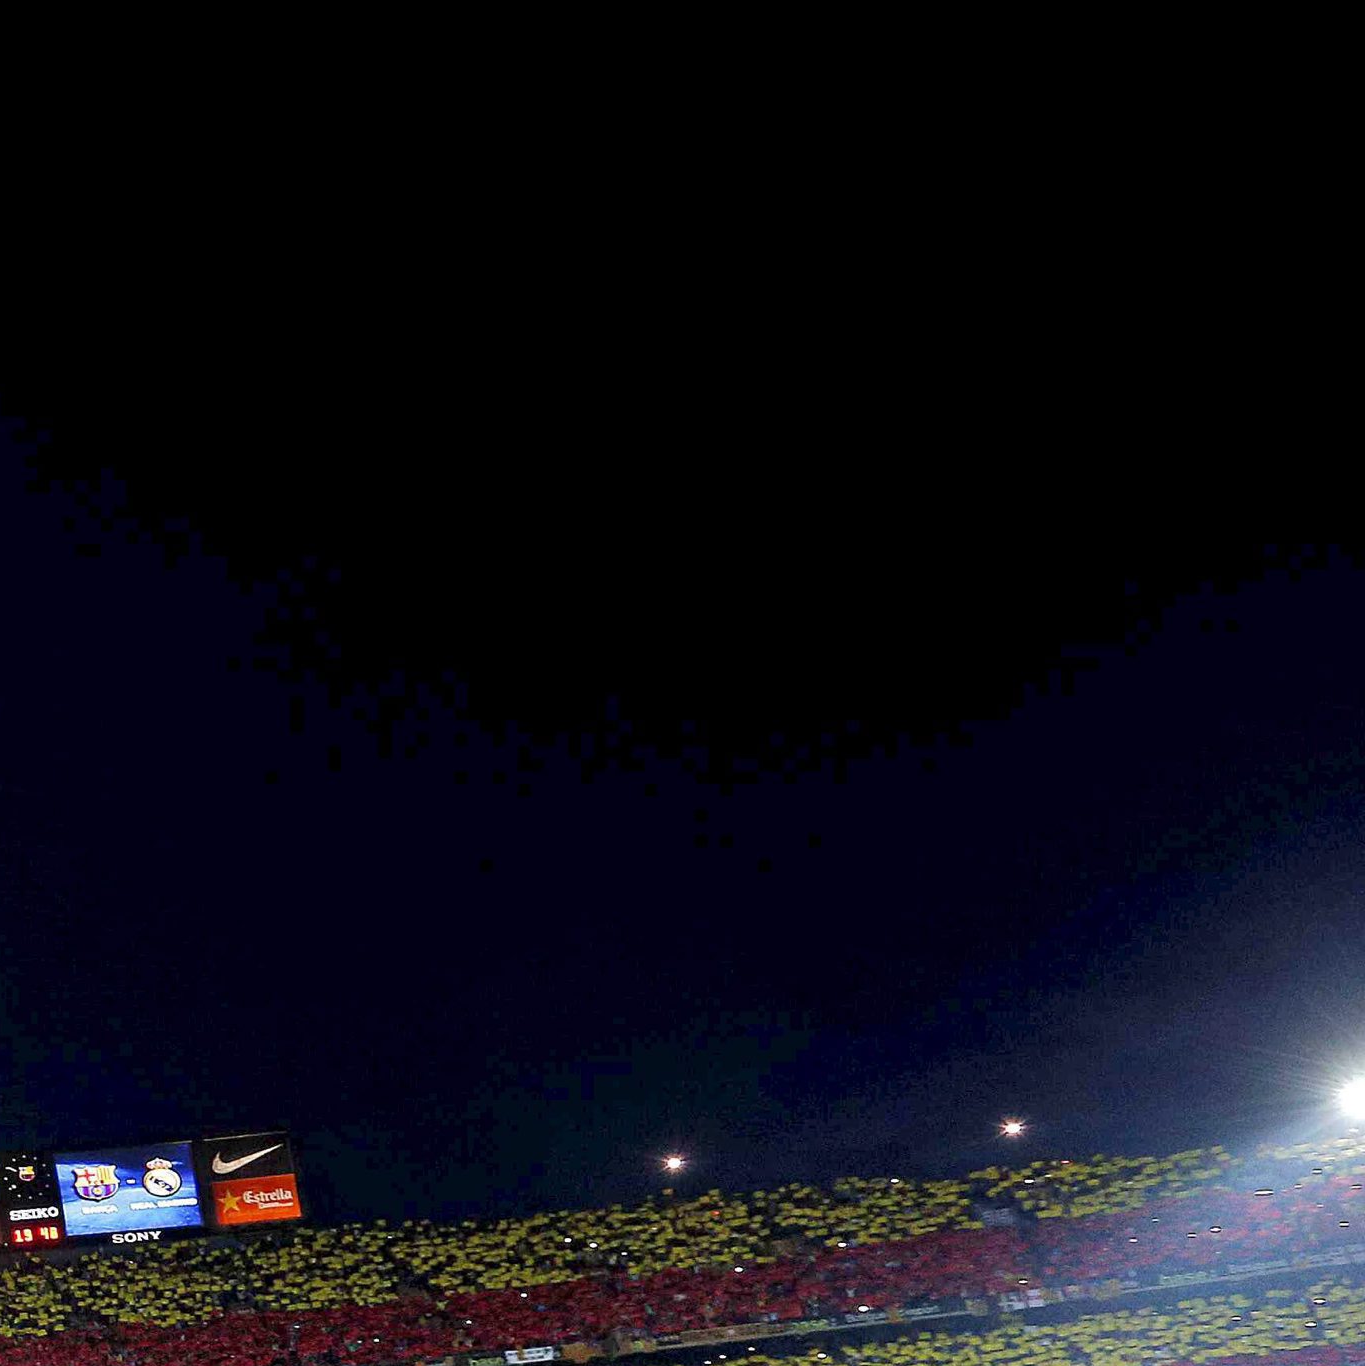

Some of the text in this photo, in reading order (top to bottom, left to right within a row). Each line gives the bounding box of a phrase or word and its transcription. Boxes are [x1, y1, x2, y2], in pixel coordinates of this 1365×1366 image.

[242, 1188, 294, 1204] Estrella
[9, 1206, 59, 1221] SEIKO
[112, 1230, 162, 1244] SONY
